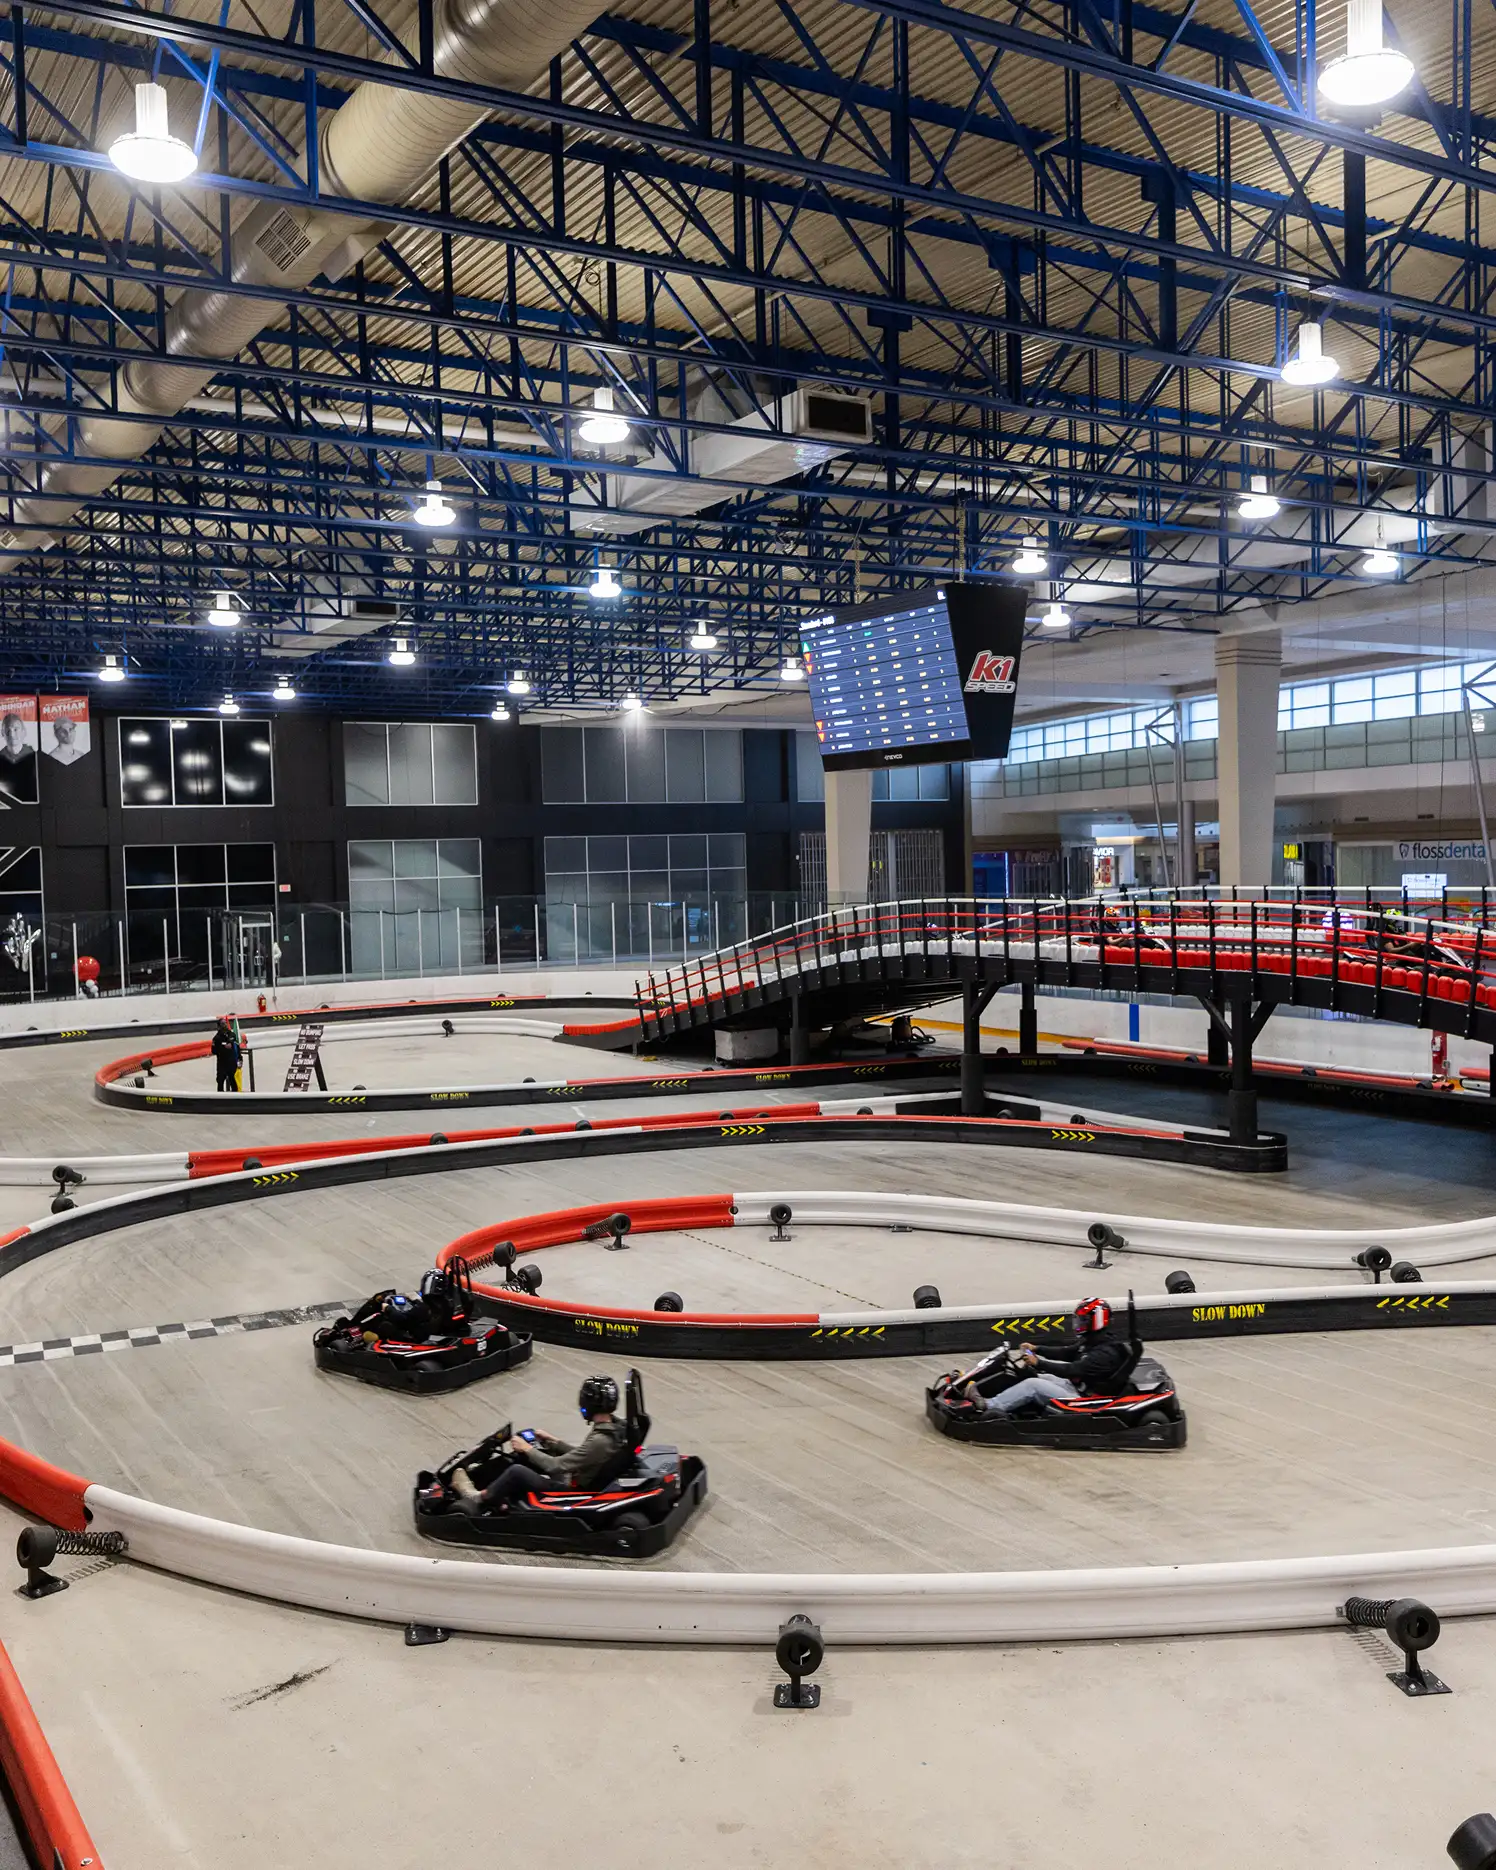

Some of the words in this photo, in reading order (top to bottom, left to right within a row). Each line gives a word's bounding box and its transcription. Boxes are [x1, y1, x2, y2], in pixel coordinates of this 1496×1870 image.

[969, 651, 1014, 682] K1
[965, 681, 1015, 692] SPEED
[43, 702, 85, 714] NATHAN
[1412, 843, 1490, 859] flossdenta
[450, 1092, 469, 1100] DOWN
[1192, 1306, 1226, 1322] SLOW
[1229, 1303, 1265, 1319] DOWN
[574, 1319, 603, 1335] SLOW
[605, 1322, 639, 1338] DOWN
